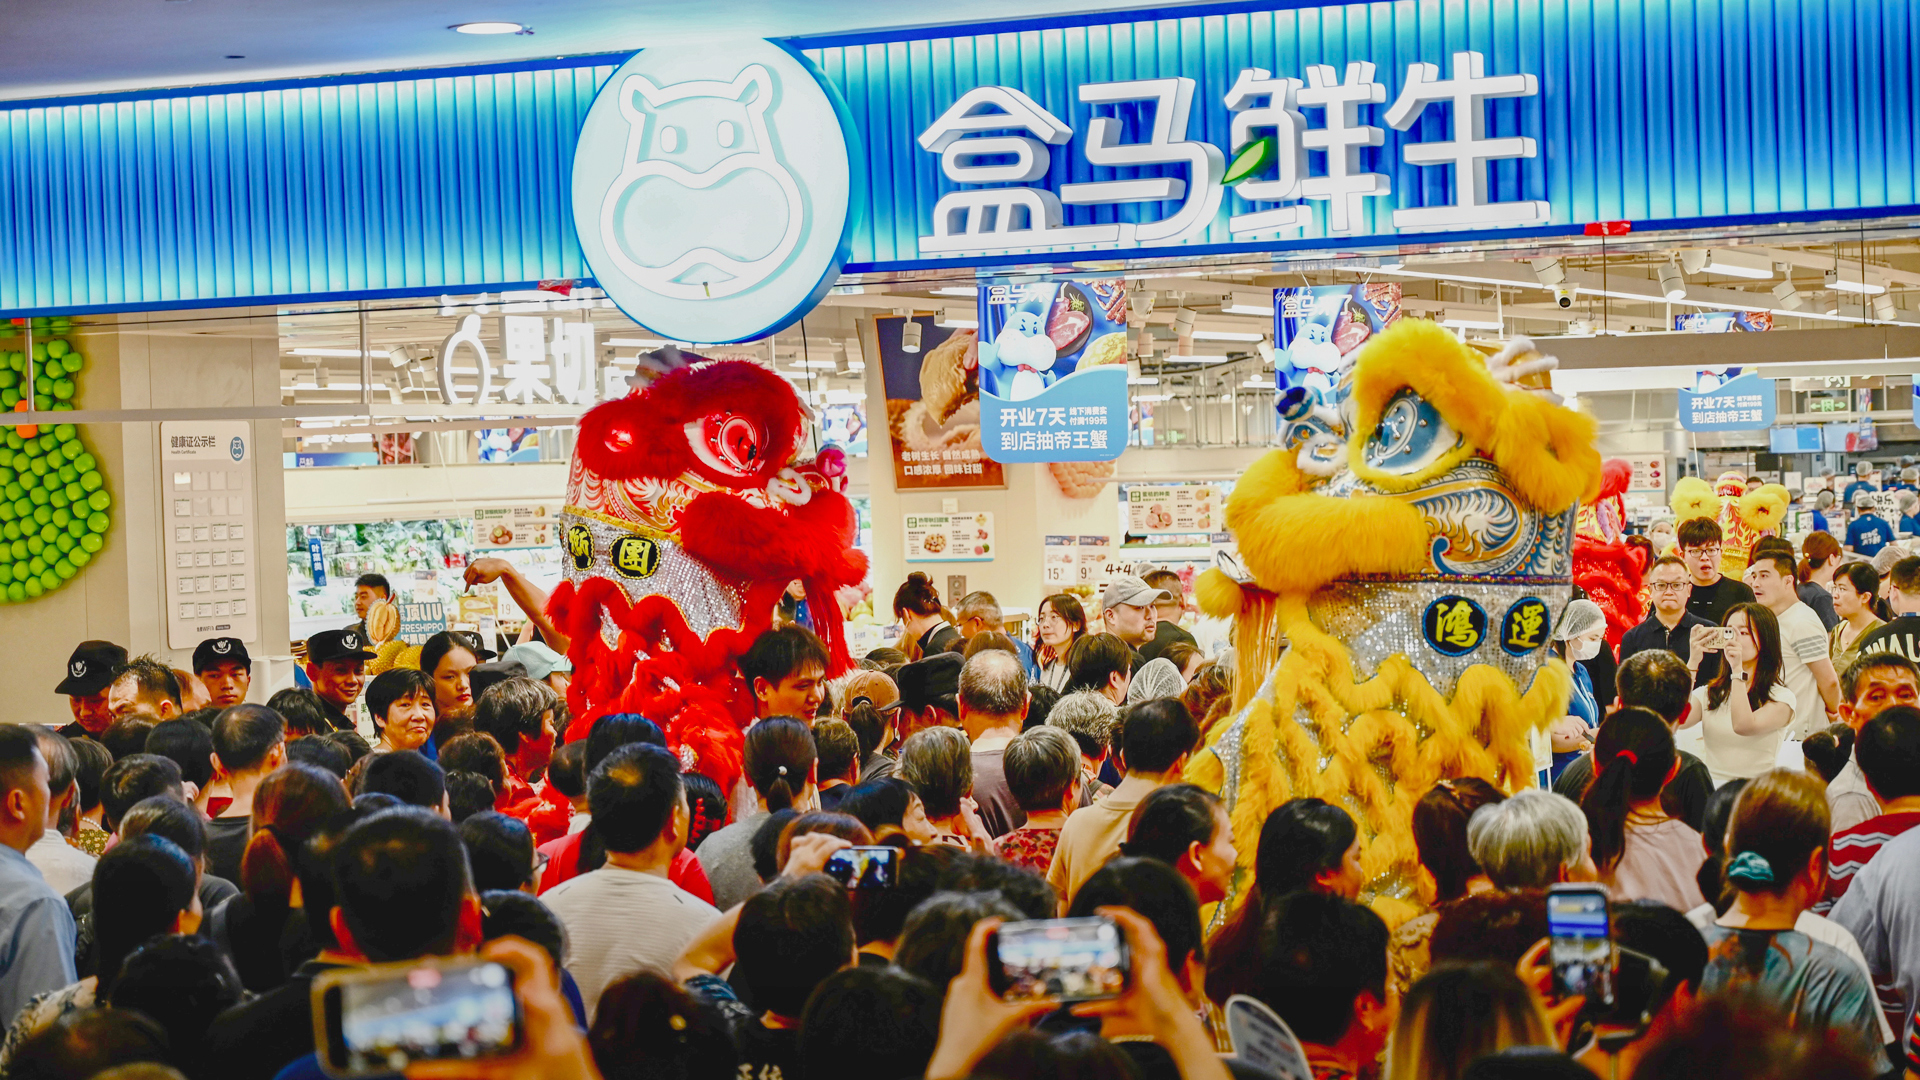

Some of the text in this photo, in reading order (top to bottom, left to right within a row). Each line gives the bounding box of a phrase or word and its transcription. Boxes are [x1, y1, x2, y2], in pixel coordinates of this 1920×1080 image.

[918, 51, 1548, 254] 盒马鲜生
[1691, 396, 1735, 410] 开业7天
[1000, 407, 1067, 427] 开业7天
[1069, 416, 1108, 426] 付满199元
[1692, 409, 1763, 424] 到店抽帝王蟹
[170, 435, 216, 448] 健康证公示栏
[1001, 430, 1108, 451] 到店抽帝王蟹
[901, 448, 981, 462] 老树生长 自然成熟
[904, 463, 983, 476] 口感浓厚 回味甘甜
[400, 622, 444, 633] FRESHIPPO
